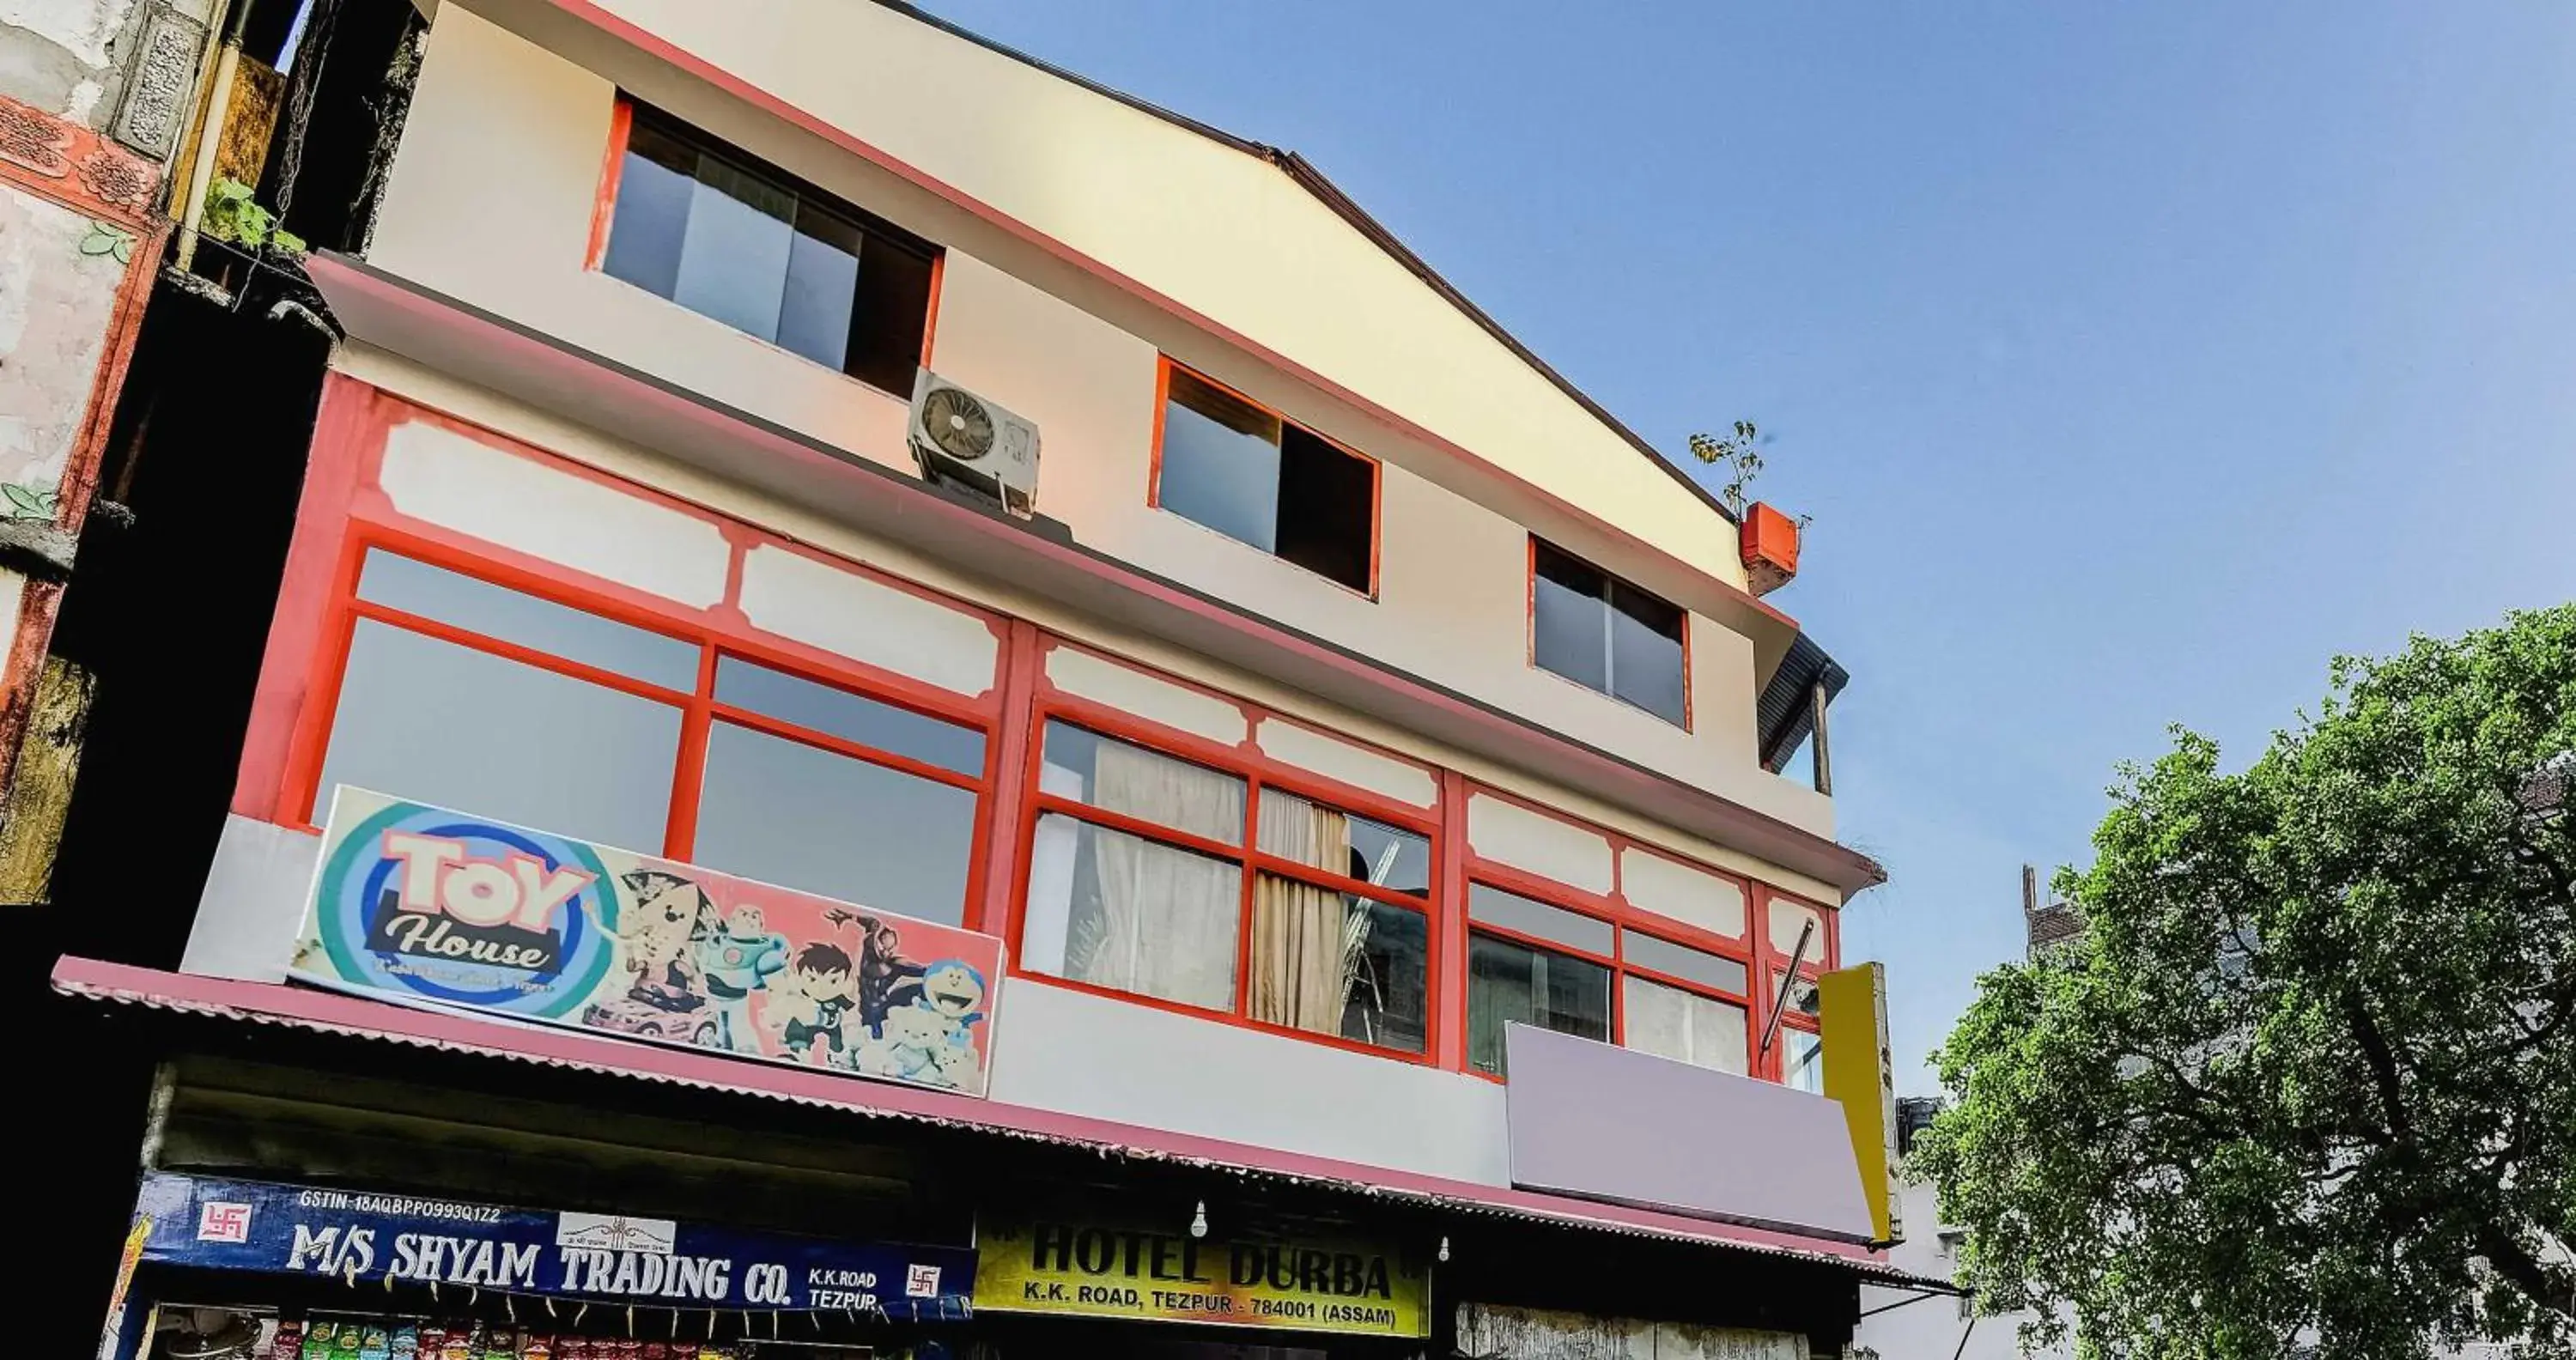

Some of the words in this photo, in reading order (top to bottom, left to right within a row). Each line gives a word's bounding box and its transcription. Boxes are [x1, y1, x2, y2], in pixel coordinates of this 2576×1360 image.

[380, 828, 599, 935] TOY
[385, 914, 550, 968] House
[285, 1223, 375, 1277] M/S
[388, 1232, 542, 1288] SHYAM
[560, 1246, 732, 1301] TRADING
[744, 1263, 792, 1306] CO.
[1032, 1222, 1212, 1284] HOTEL
[1230, 1240, 1392, 1301] DURBA
[1024, 1281, 1071, 1302] K.K.
[1078, 1286, 1145, 1311] ROAD,
[1151, 1290, 1233, 1313] TEZPUR
[1250, 1298, 1315, 1319] 784001
[1322, 1304, 1396, 1329] (ASSAM)
